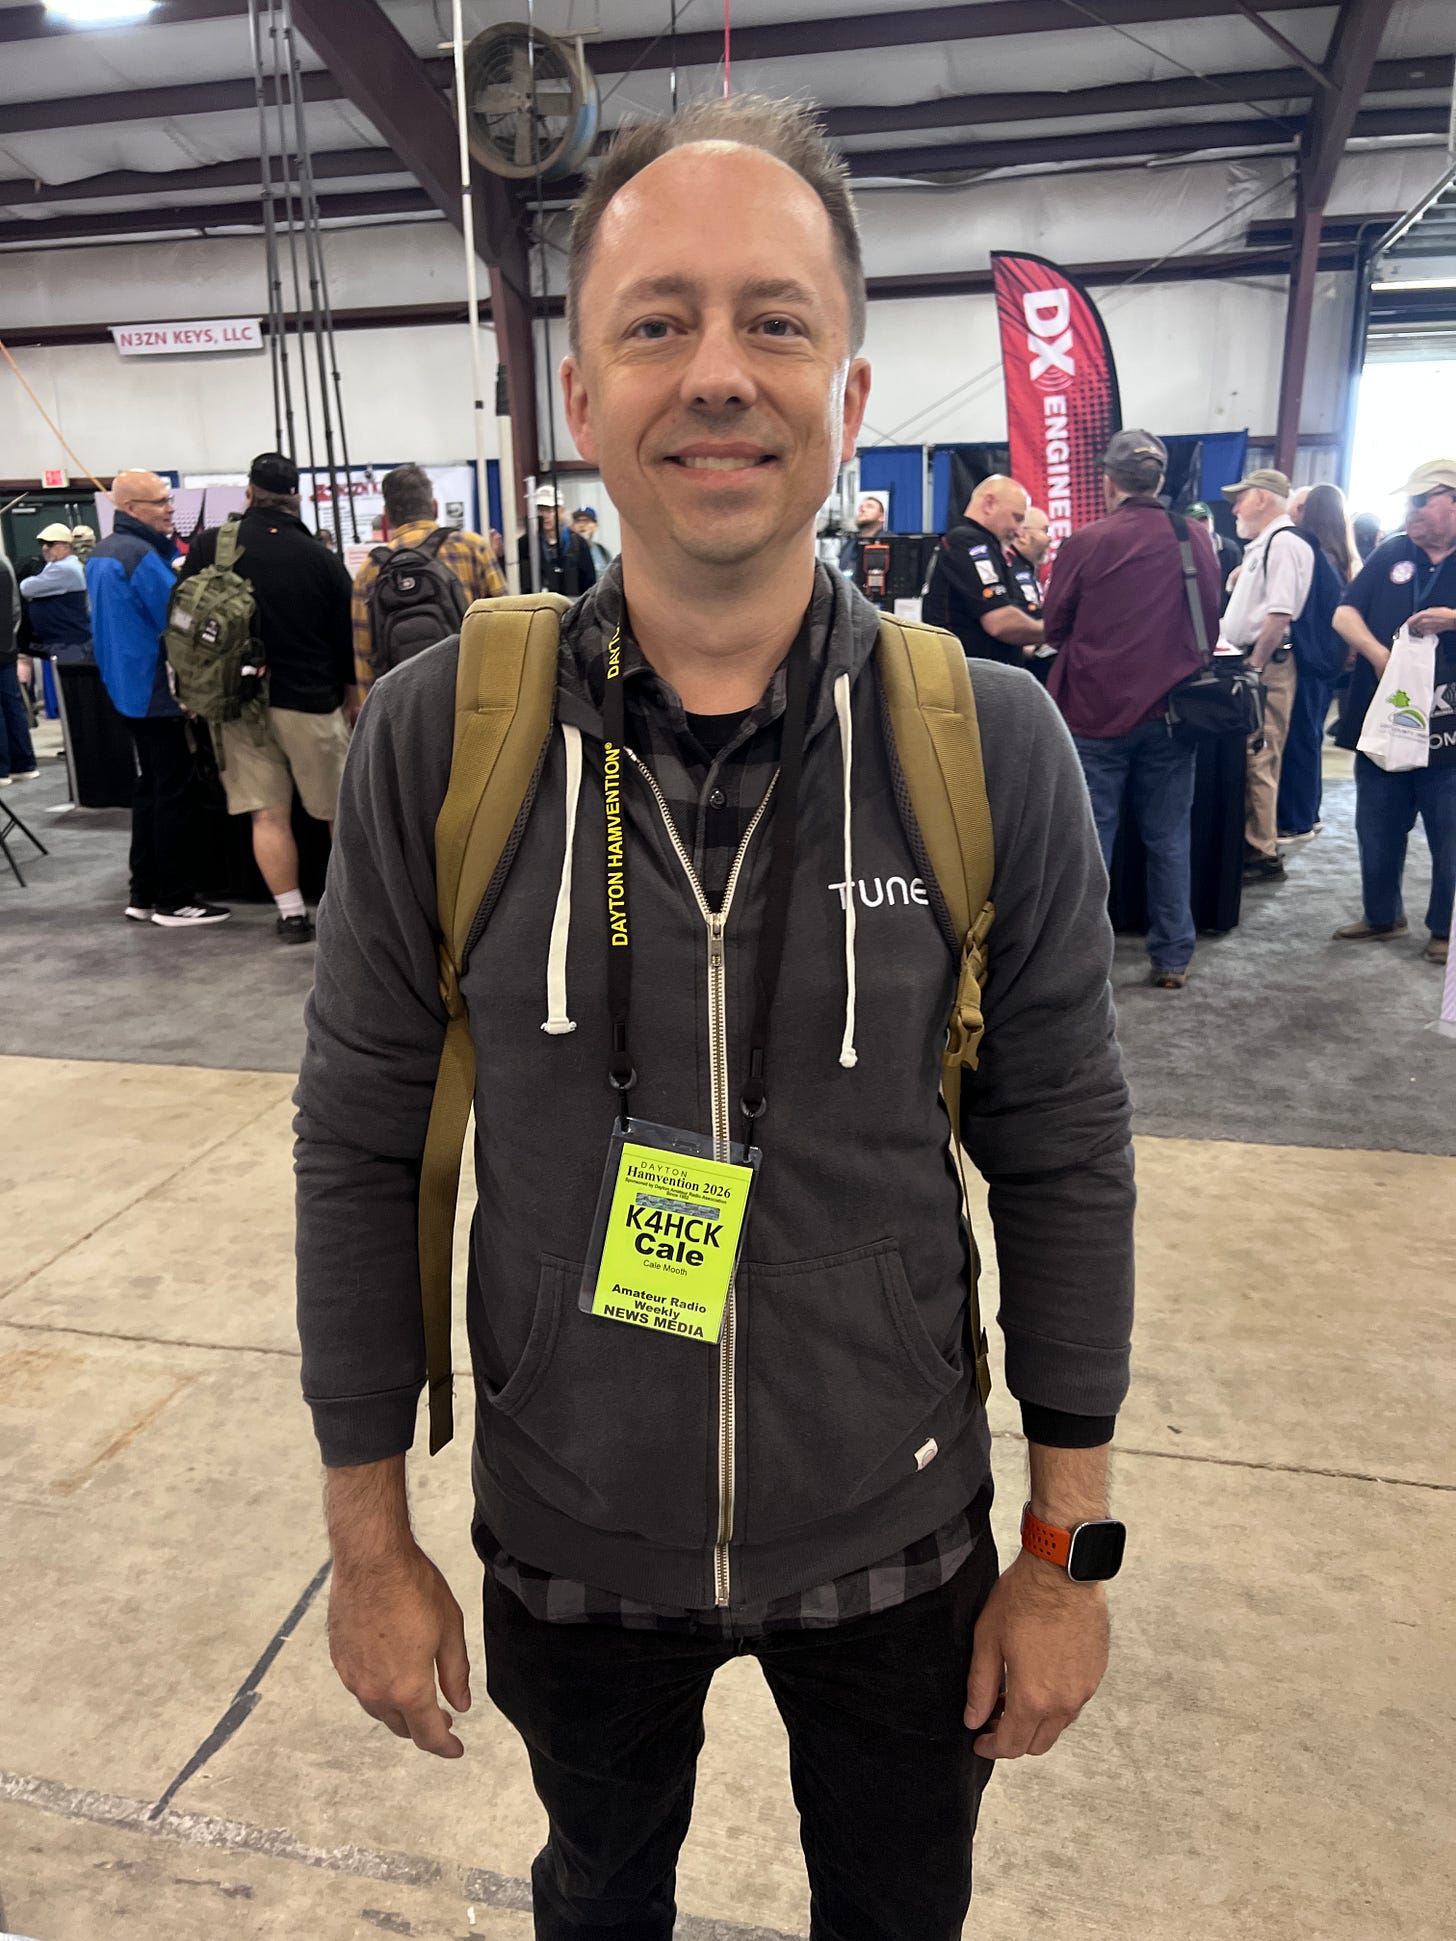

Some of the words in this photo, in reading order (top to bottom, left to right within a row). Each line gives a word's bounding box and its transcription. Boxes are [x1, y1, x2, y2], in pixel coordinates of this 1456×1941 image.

[120, 332, 167, 347] N3ZN
[173, 329, 218, 345] KEYS,
[223, 327, 253, 342] LLC
[1023, 288, 1075, 381] DX
[1043, 395, 1072, 560] ENGINEE
[607, 872, 628, 946] DAYTON
[627, 1165, 699, 1192] Hamvention
[703, 1183, 731, 1199] 2026
[640, 1161, 688, 1178] DAYTON
[654, 1183, 670, 1192] Dayton
[626, 1204, 724, 1248] K4HCK
[635, 1232, 704, 1267] Cale
[643, 1259, 661, 1270] Cale
[663, 1263, 688, 1276] Mooth
[612, 1283, 667, 1304] Amateur
[670, 1297, 707, 1314] Radio
[634, 1300, 681, 1320] Weekly
[603, 1304, 649, 1324] NEWS
[654, 1316, 704, 1338] MEDIA
